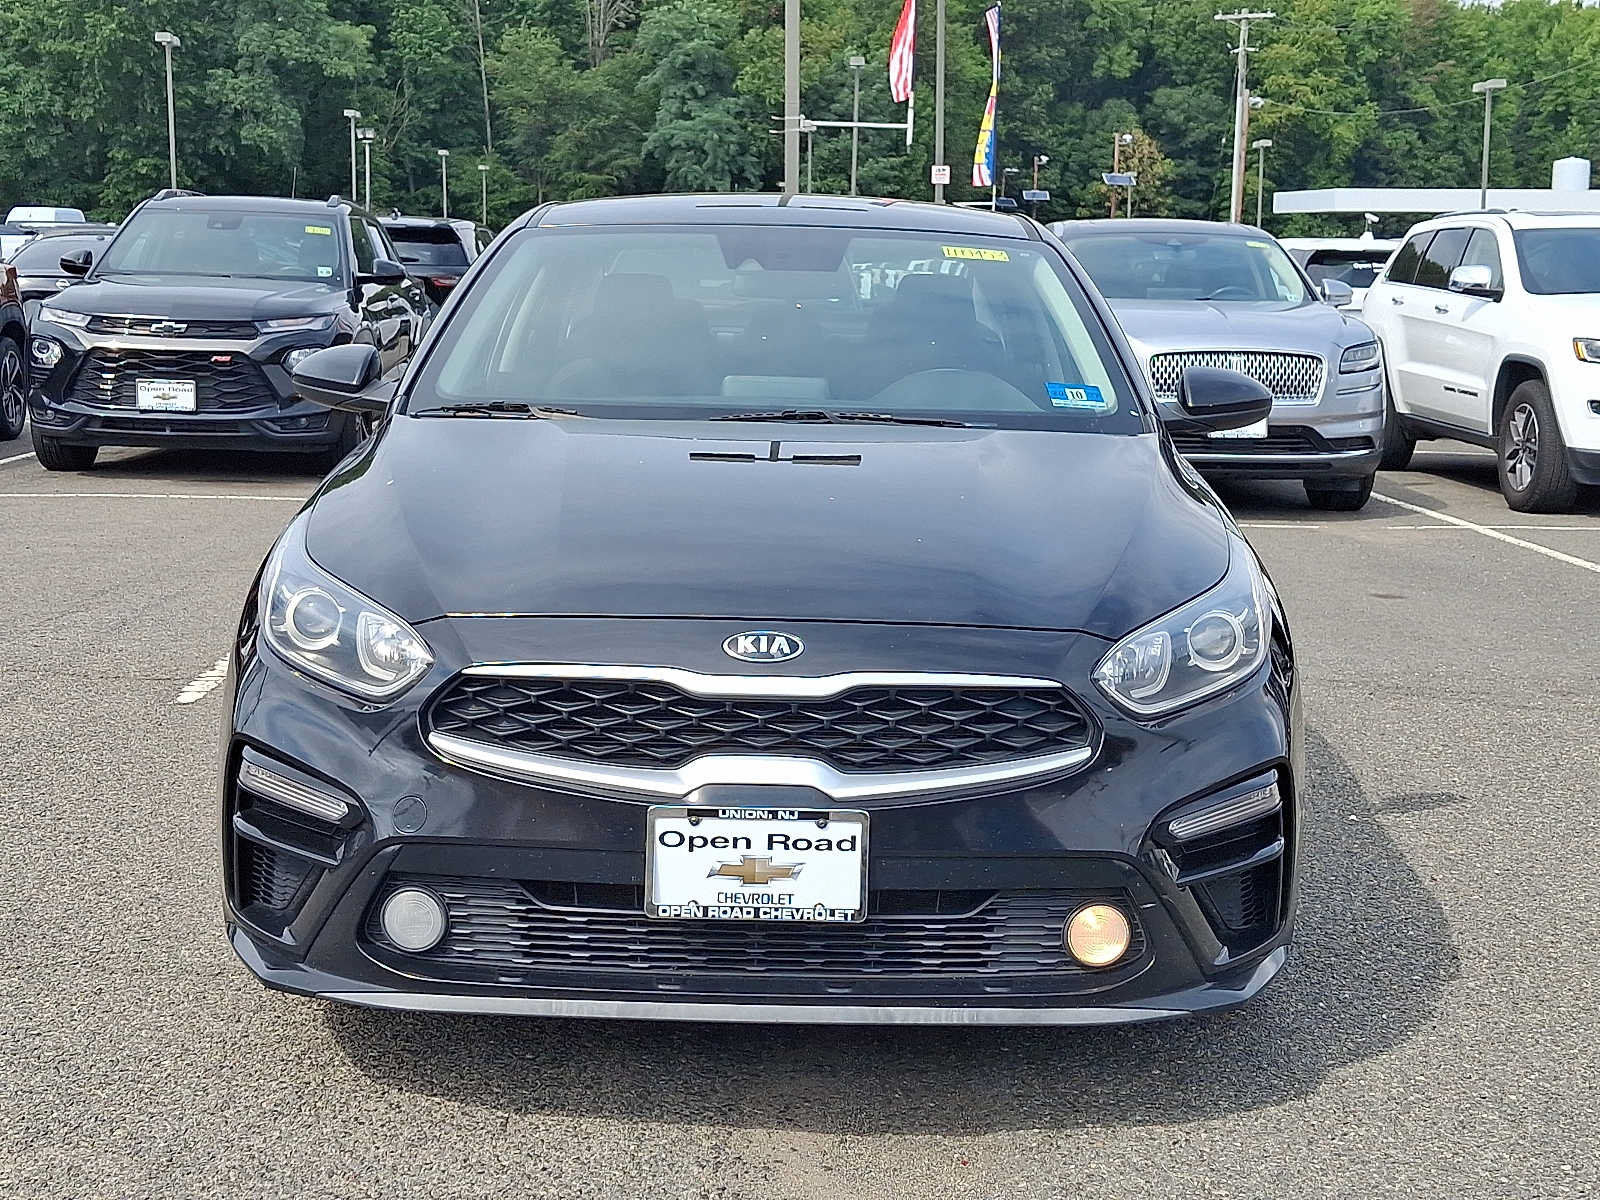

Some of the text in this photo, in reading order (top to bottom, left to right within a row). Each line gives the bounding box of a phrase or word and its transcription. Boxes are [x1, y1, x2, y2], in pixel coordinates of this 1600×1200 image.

[1069, 390, 1083, 400] 10
[737, 635, 791, 654] KIA
[718, 809, 799, 820] UNION, NJ
[658, 830, 857, 852] Open Road
[716, 891, 795, 905] CHEVROLET
[657, 905, 856, 921] OPEN ROAD CHEVROLET
